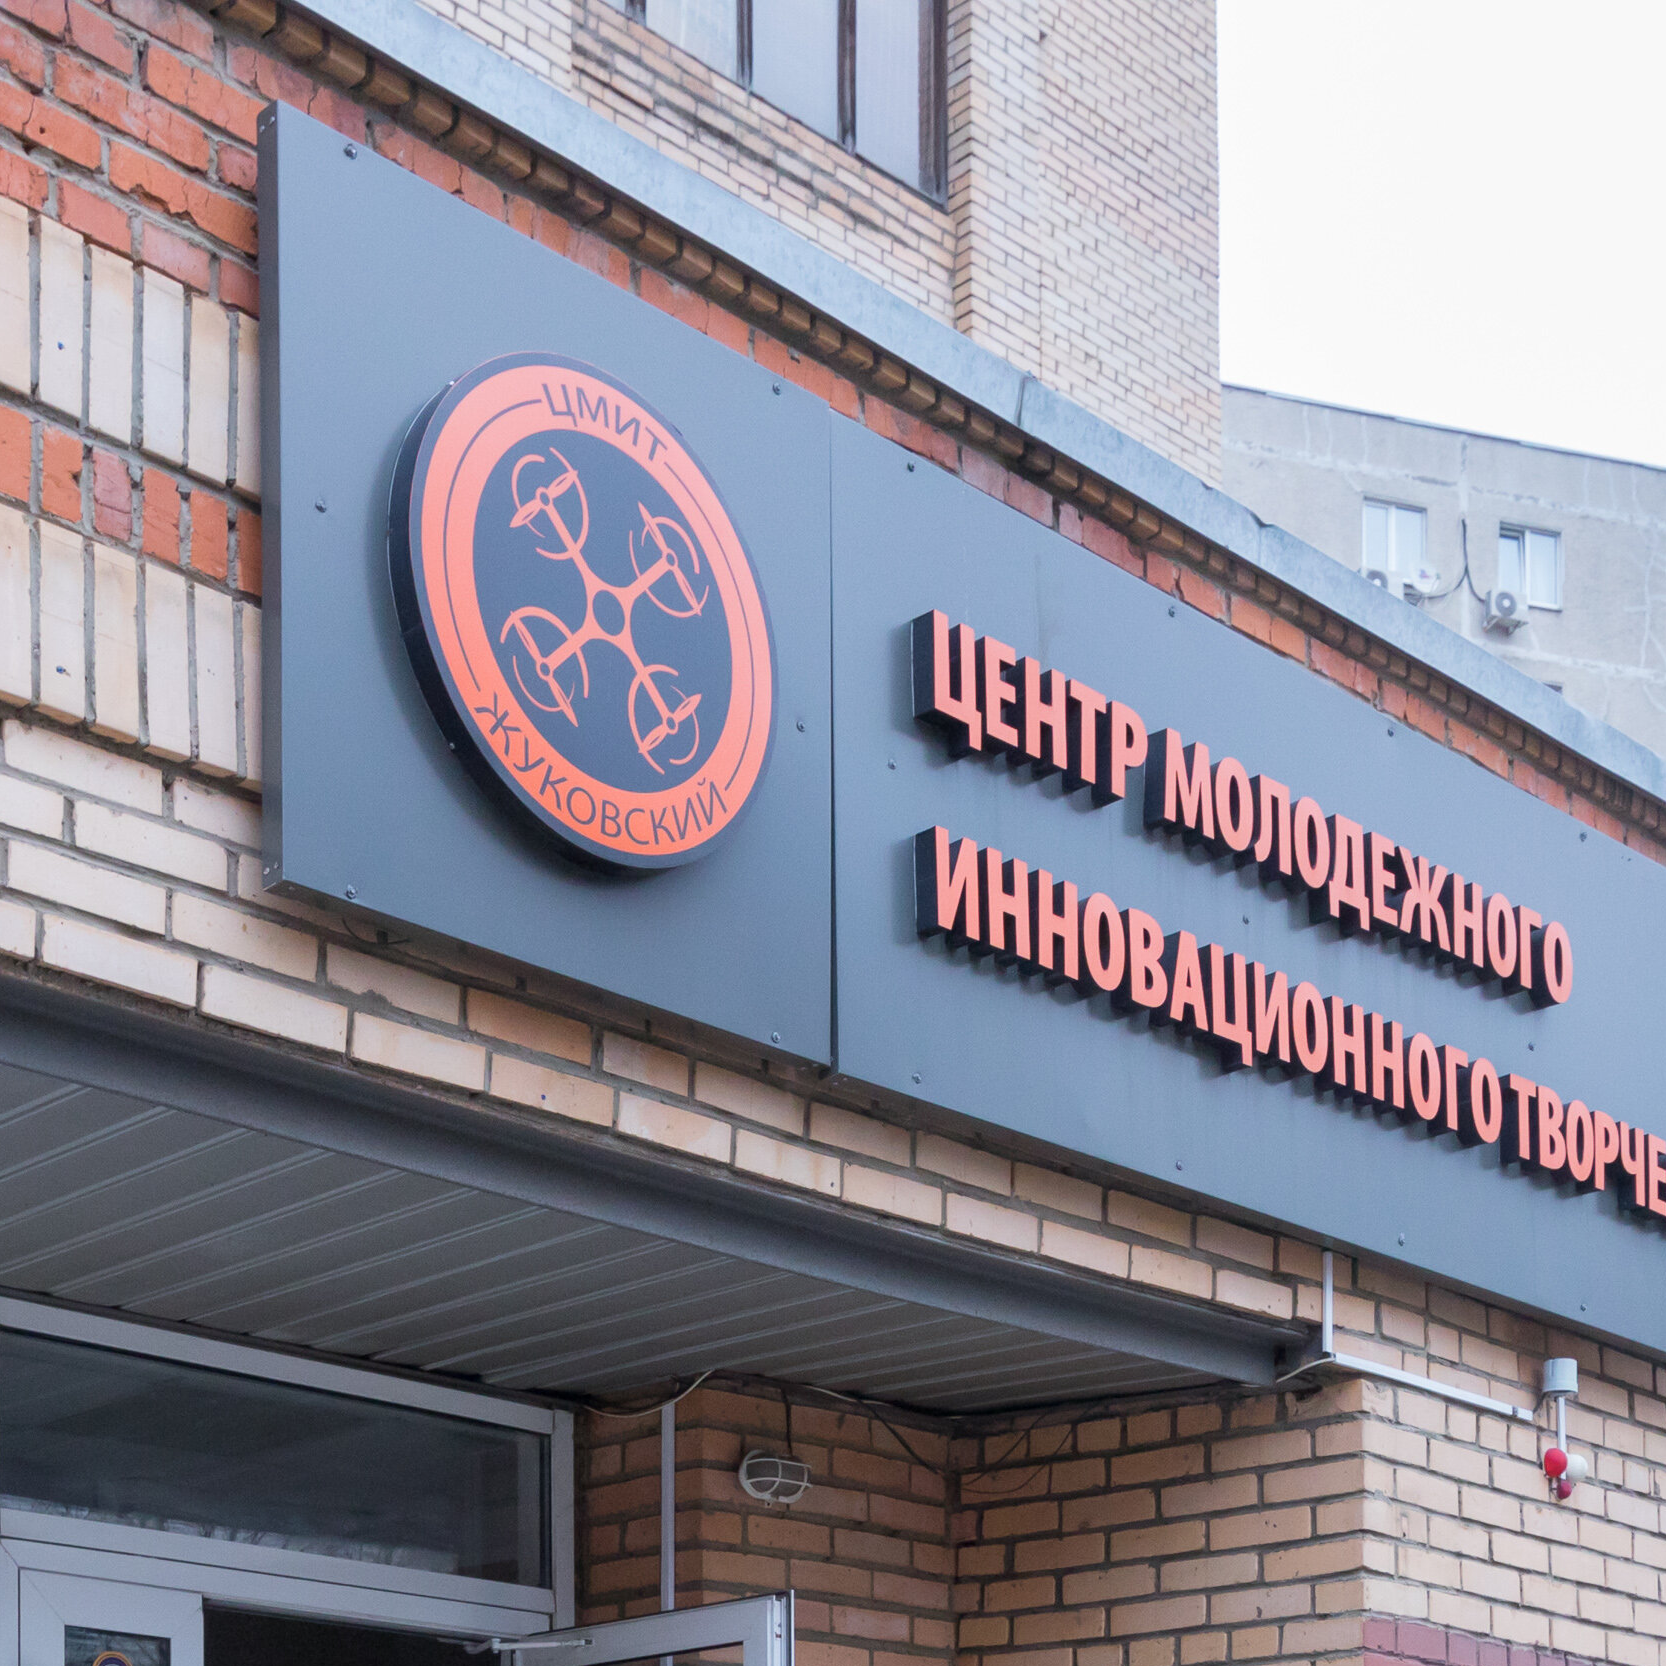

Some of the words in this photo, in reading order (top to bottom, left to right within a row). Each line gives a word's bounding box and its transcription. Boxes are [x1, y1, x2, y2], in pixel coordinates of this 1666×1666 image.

[540, 381, 670, 466] ЦМИТ
[474, 692, 727, 847] ЖУКОВСКИЙ
[925, 609, 1148, 803] ЦЕНТР
[1155, 728, 1574, 1006] МОЛОДЕЖНОГО
[927, 826, 1502, 1146] ИННОВАЦИОННОГО
